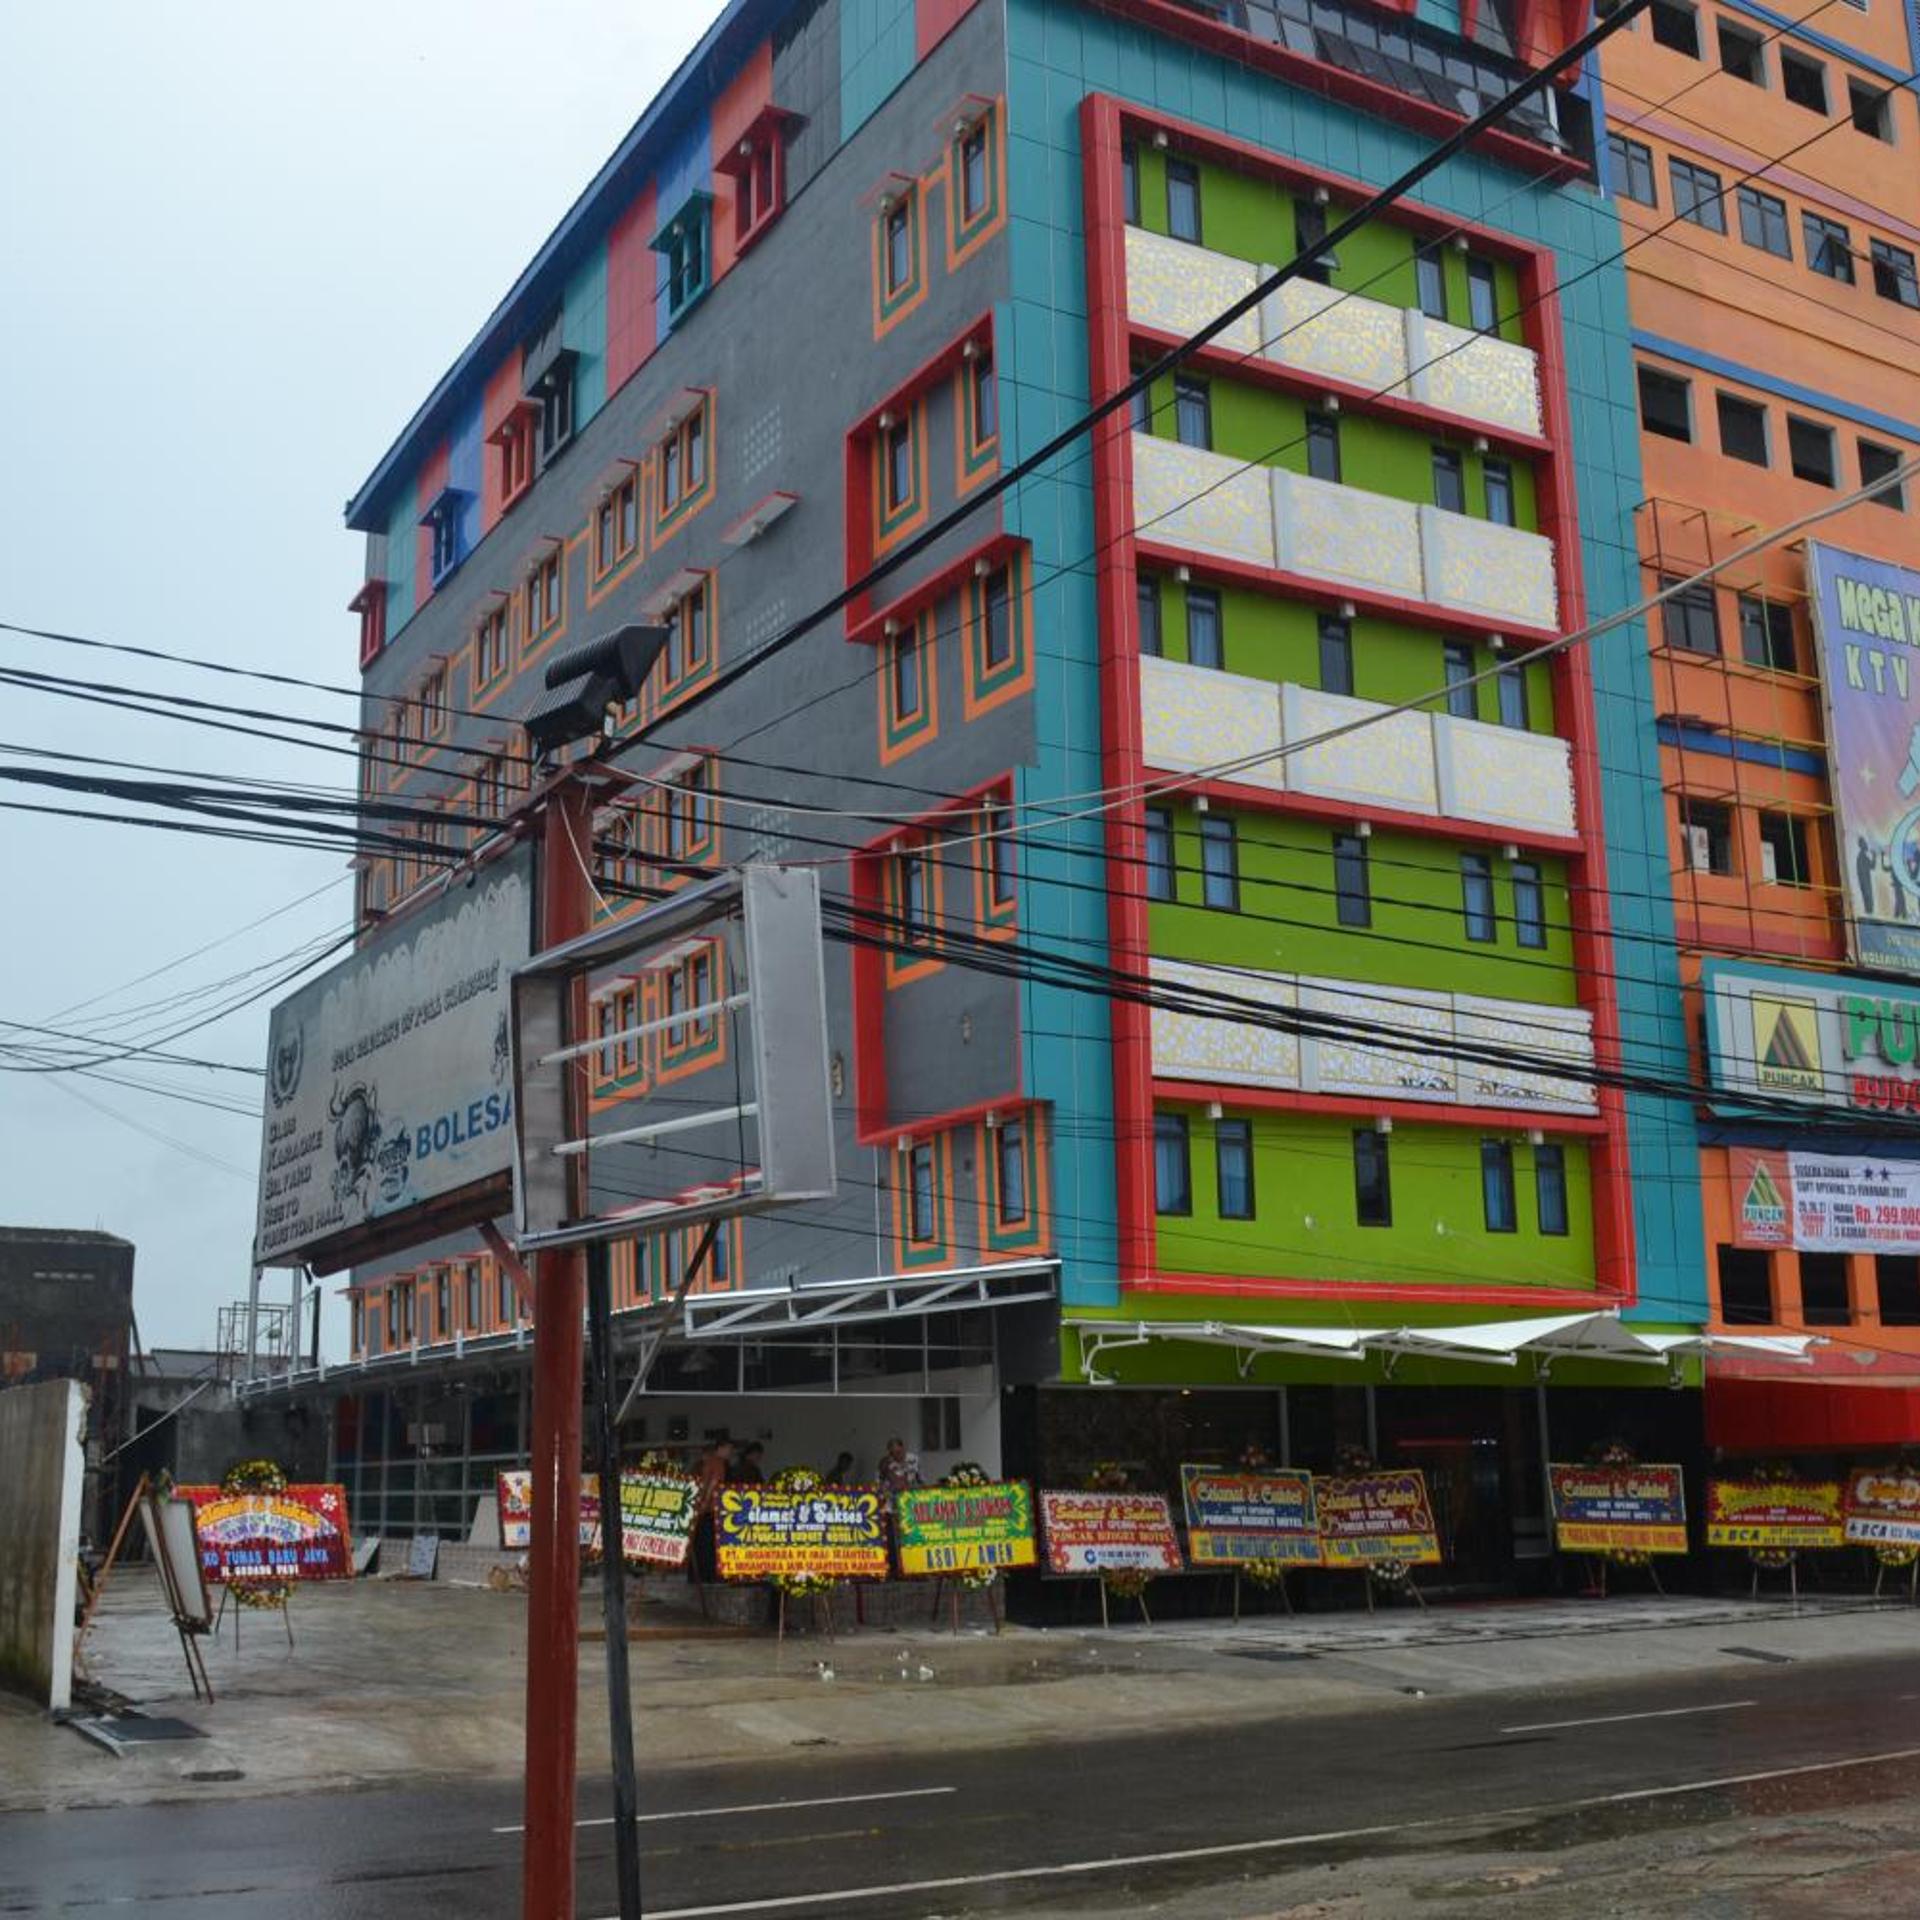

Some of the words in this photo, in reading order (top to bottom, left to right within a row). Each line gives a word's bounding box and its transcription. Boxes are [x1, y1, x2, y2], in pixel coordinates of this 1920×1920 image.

[1843, 996, 1920, 1064] PU
[1763, 1071, 1817, 1089] PUNCAK
[1860, 1522, 1888, 1537] BCA
